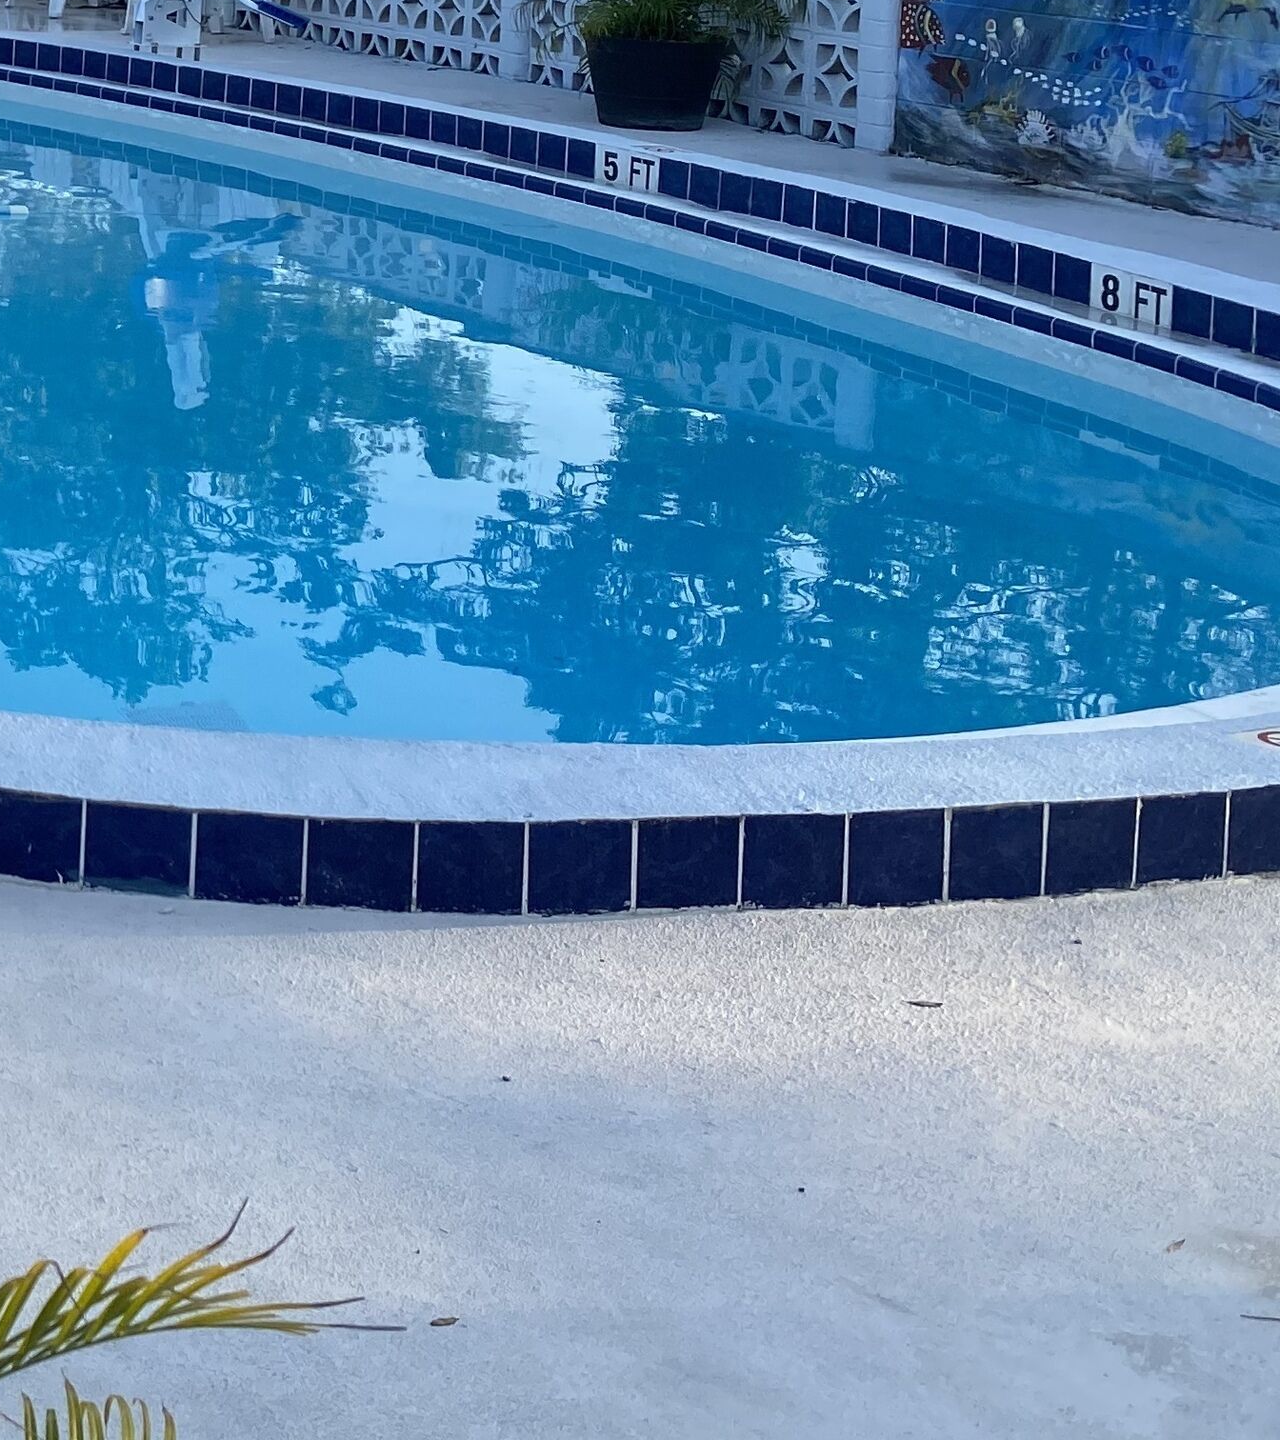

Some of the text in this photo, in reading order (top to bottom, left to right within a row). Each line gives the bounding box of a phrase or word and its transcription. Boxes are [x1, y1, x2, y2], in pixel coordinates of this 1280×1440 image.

[604, 151, 655, 190] 5 FT
[1101, 274, 1168, 326] 8 FT
